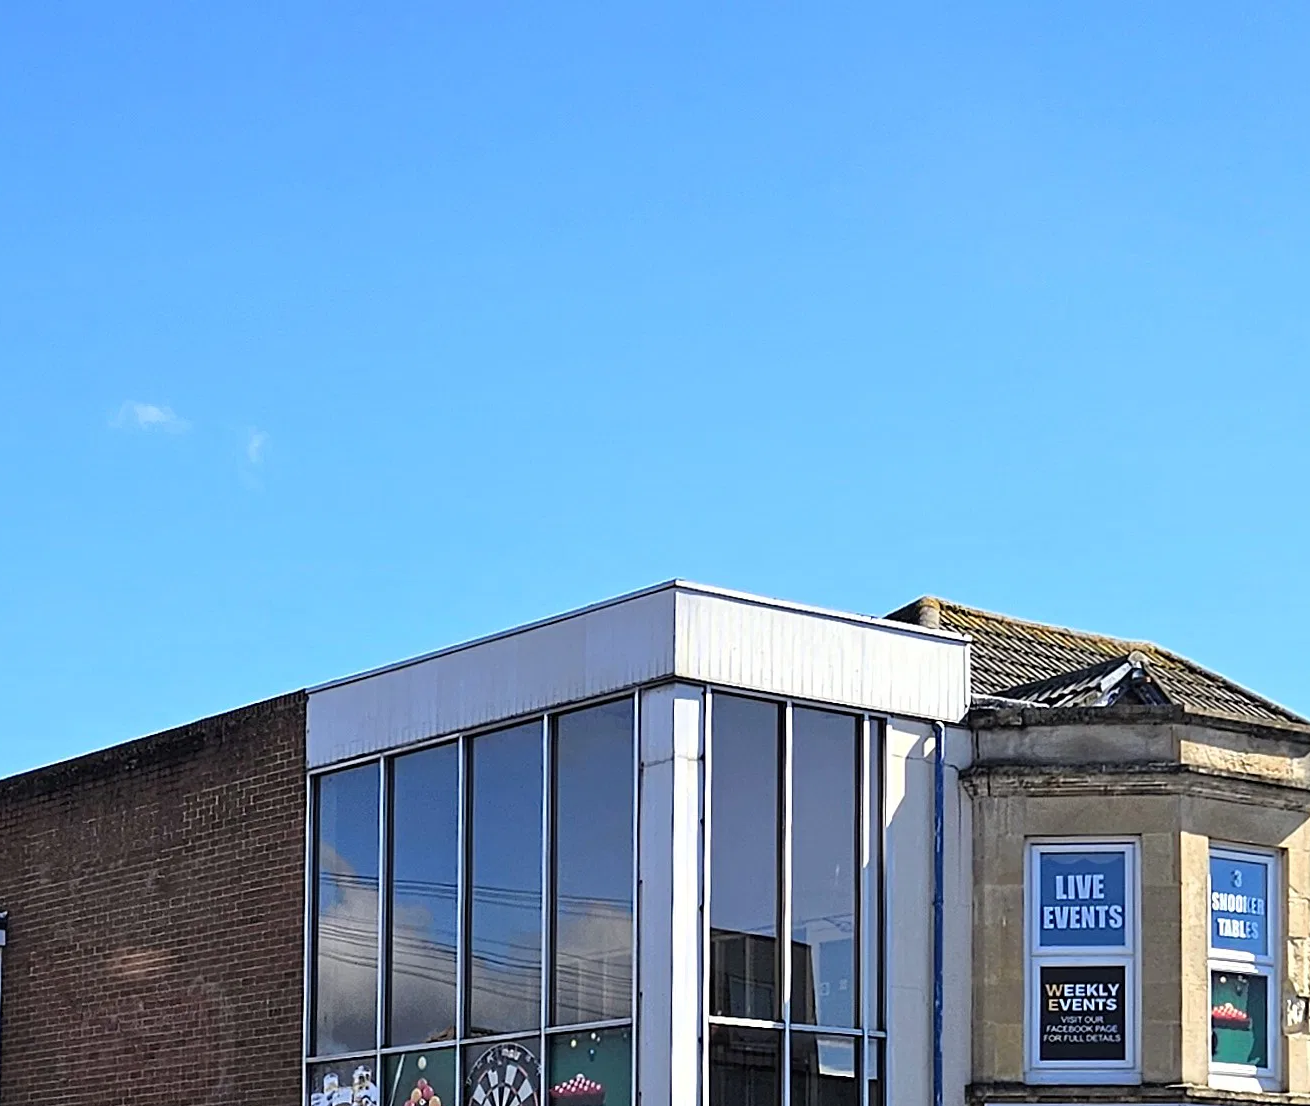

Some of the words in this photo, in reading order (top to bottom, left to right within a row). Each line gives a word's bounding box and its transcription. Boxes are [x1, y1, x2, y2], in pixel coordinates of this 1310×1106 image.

[1232, 869, 1243, 888] 3
[1055, 874, 1105, 900] LIVE
[1211, 891, 1265, 916] SNOOKER
[1043, 905, 1123, 929] EVENTS
[1216, 918, 1259, 940] TABLES
[1045, 983, 1120, 997] WEEKLY
[1048, 998, 1117, 1012] EVENTS
[1060, 1015, 1082, 1024] VISIT
[1084, 1015, 1104, 1024] OUR
[1046, 1025, 1094, 1033] FACEBOOK
[1095, 1025, 1118, 1033] PAGE
[1043, 1034, 1062, 1043] FOR
[1063, 1034, 1085, 1043] FULL
[1085, 1034, 1122, 1043] DETAILS
